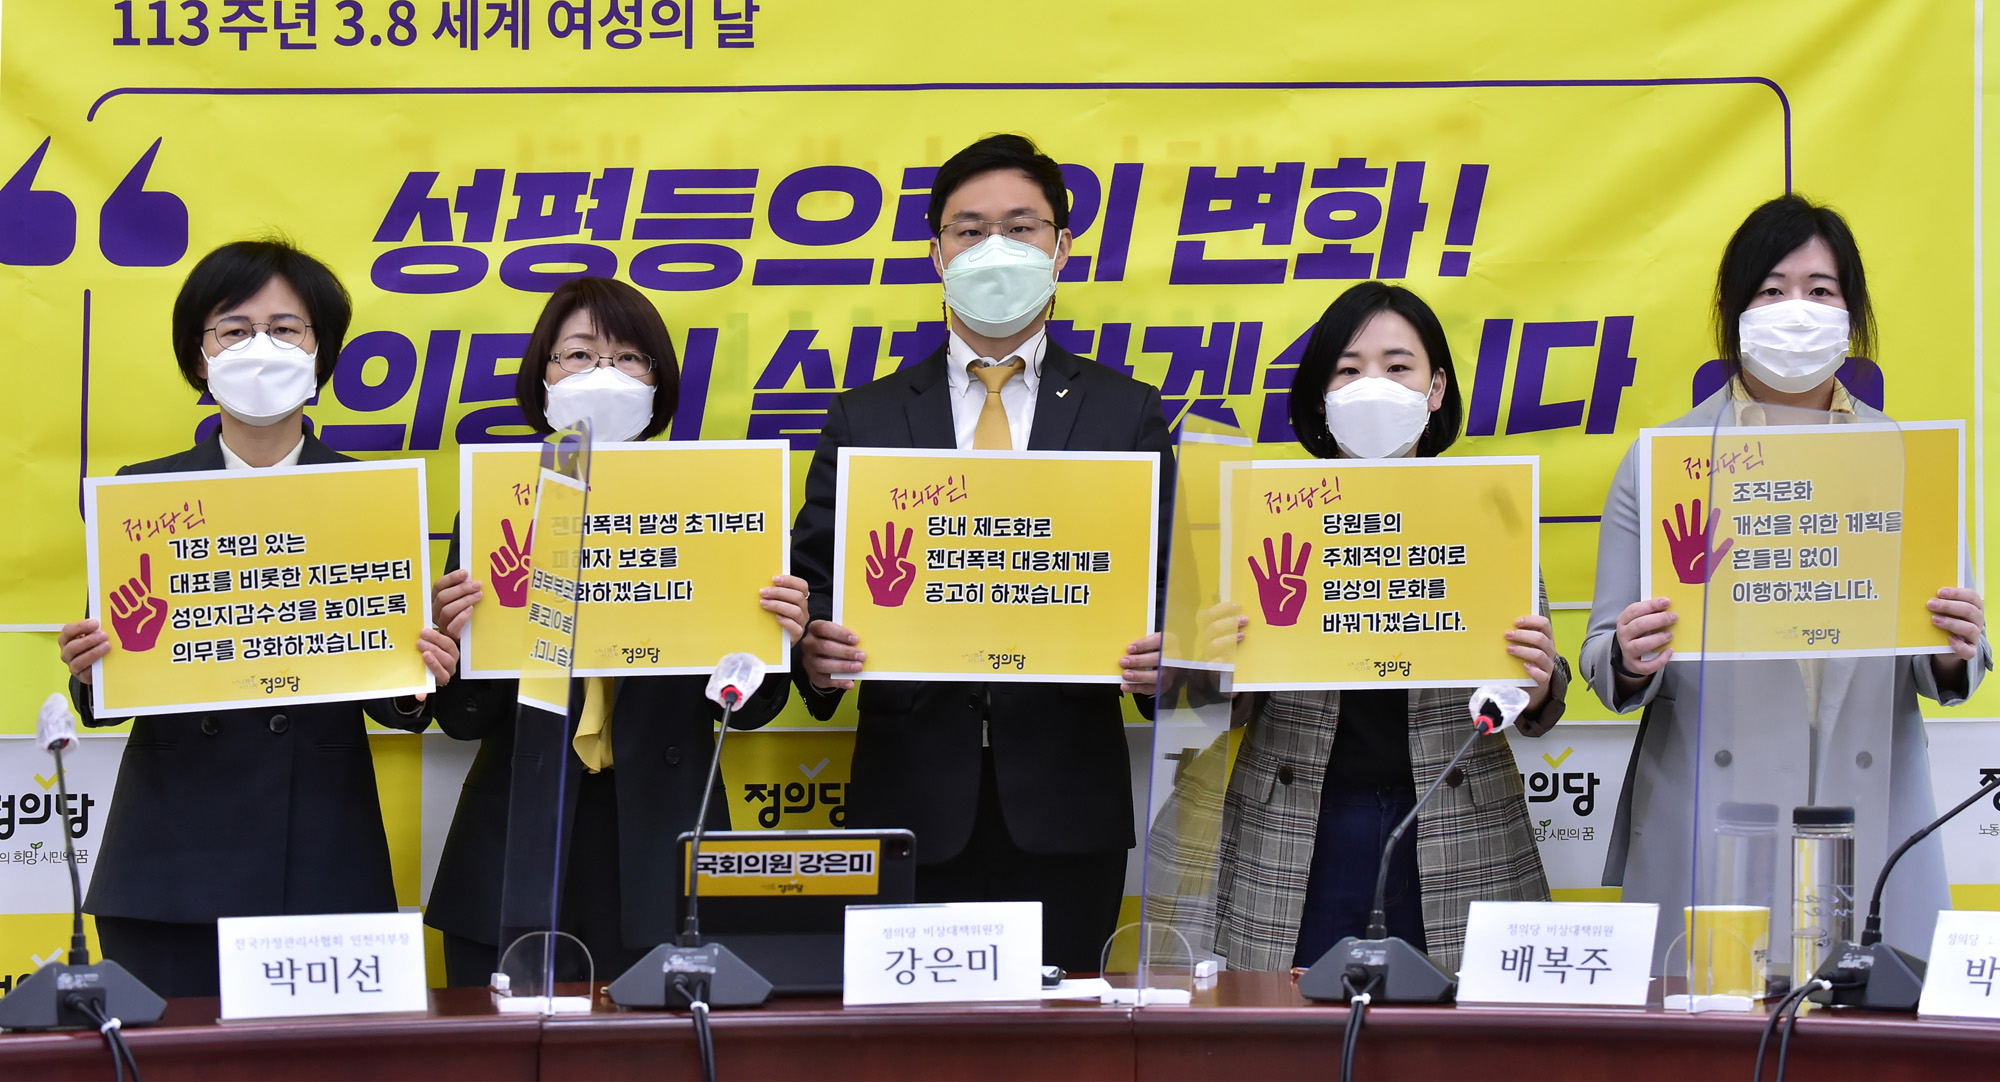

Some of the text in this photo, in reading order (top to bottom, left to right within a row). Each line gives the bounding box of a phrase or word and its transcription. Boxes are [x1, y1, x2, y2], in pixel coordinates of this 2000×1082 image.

[334, 0, 417, 47] 3.8
[433, 0, 530, 51] 세계
[547, 0, 695, 51] 여성의
[713, 0, 759, 49] 날
[1733, 481, 1812, 502] 조직문화
[640, 514, 677, 534] 발생
[685, 512, 764, 533] 초기부터
[928, 517, 1051, 537] 당내 제도화로
[1324, 514, 1401, 534] 당원들의
[1733, 512, 1902, 536] 개선을 위한 계획을
[169, 533, 305, 559] 가장 책임 있는
[1323, 546, 1466, 567] 주체적인 참여로
[619, 547, 677, 568] 보호를
[927, 550, 1110, 572] 젠더폭력 대응체계를
[1733, 548, 1838, 570] 흔들림 없이
[170, 560, 411, 594] 대표를 비롯한 지도부부터
[926, 583, 1089, 604] 공고히 하겠습니다
[1323, 578, 1446, 601] 일상의 문화를
[1733, 580, 1878, 603] 이행하겠습니다.
[171, 593, 407, 629] 성인지감수성을 높이도록
[1323, 612, 1466, 633] 바꿔가겠습니다.
[172, 630, 393, 663] 의무를 강화하겠습니다.
[1802, 629, 1840, 645] 정의당
[621, 648, 660, 664] 정의당
[988, 654, 1026, 670] 정의당
[1374, 661, 1412, 677] 정의당
[260, 676, 300, 694] 정의당
[1520, 771, 1600, 816] 의당
[1549, 828, 1579, 841] 시민의
[1582, 827, 1594, 841] 꿈
[13, 848, 38, 865] 희망
[698, 853, 872, 875] 국회의원 강은미
[883, 924, 1004, 939] 정의당 비상대책위원장
[1508, 924, 1613, 937] 정의당 비상대책위원
[1948, 932, 1979, 946] 정의당
[262, 954, 383, 996] 박미선
[885, 944, 997, 985] 강은미
[1501, 944, 1612, 985] 배복주
[1966, 956, 2000, 997] 박
